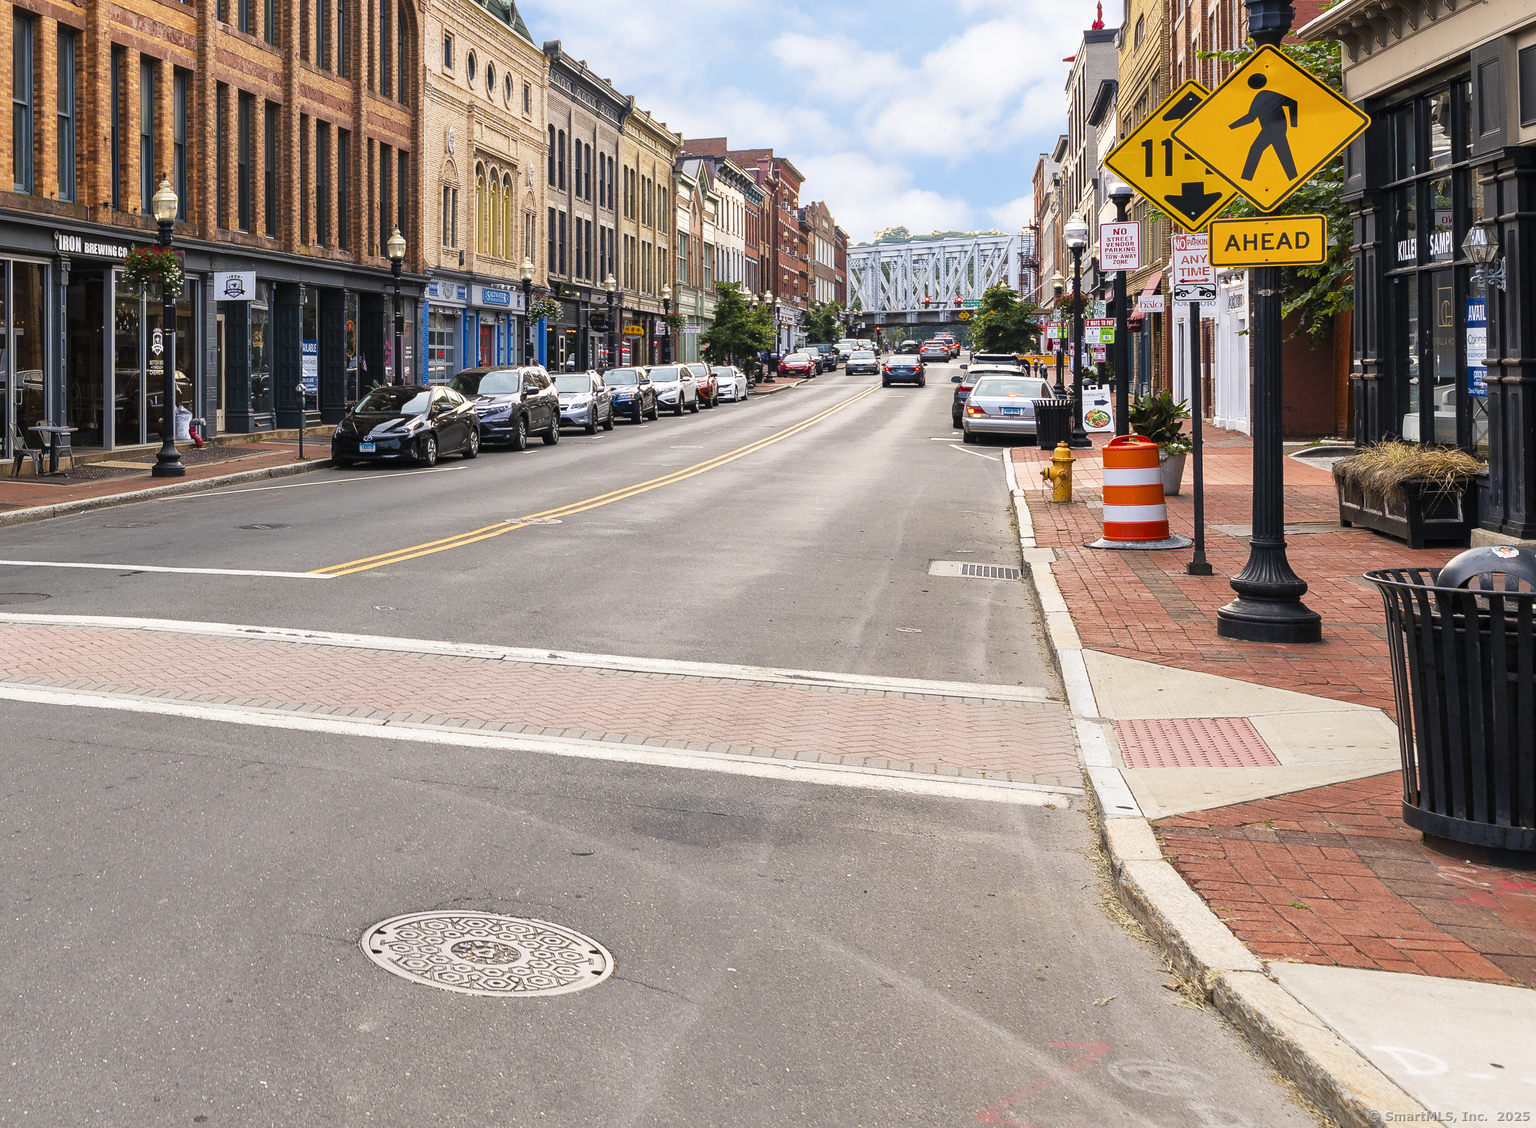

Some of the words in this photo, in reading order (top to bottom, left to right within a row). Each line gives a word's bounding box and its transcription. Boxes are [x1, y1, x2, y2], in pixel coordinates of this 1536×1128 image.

[58, 234, 82, 253] IRON
[84, 242, 118, 257] BREWING
[1175, 238, 1186, 249] NO
[1187, 238, 1208, 246] PARKIN
[1224, 231, 1310, 252] AHEAD
[1398, 238, 1417, 262] KILLE
[1429, 231, 1453, 256] SAMPL
[1181, 254, 1208, 265] ANY
[1178, 266, 1211, 277] TIME
[1139, 299, 1163, 309] halo
[1468, 304, 1487, 321] AVAIL
